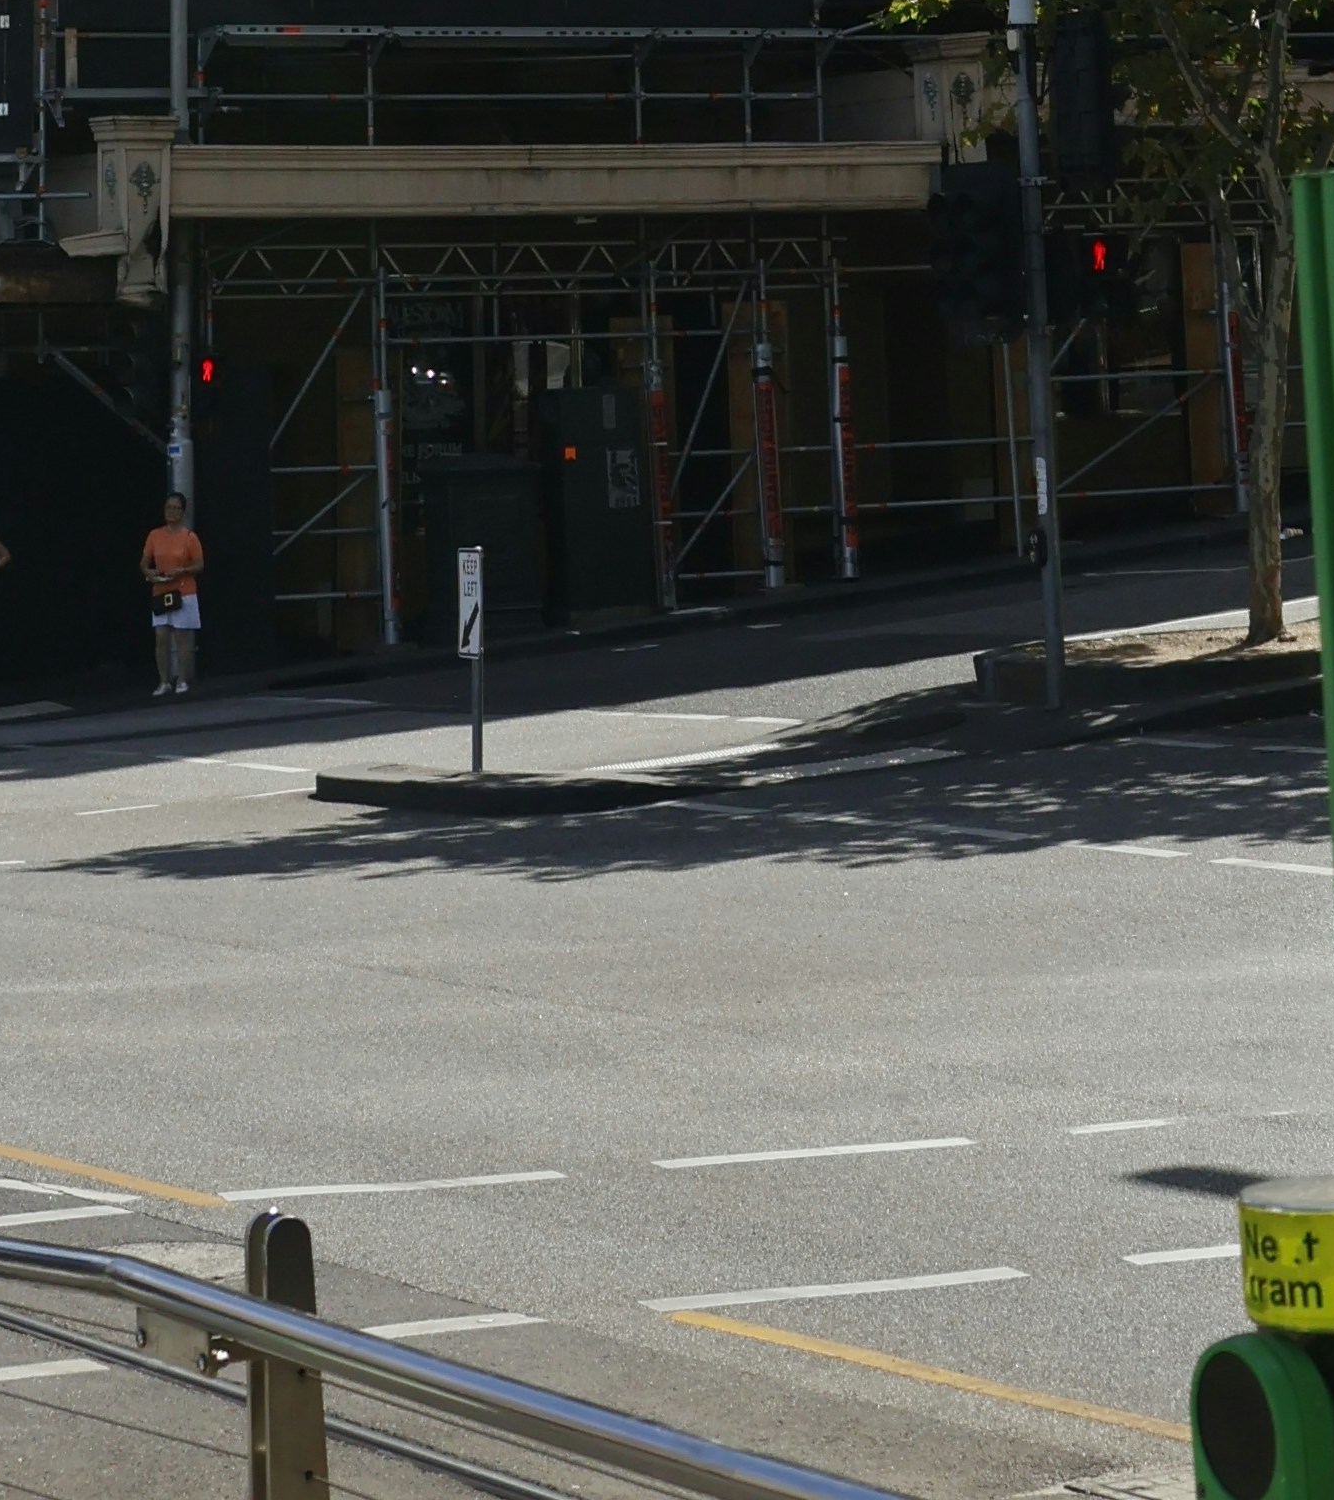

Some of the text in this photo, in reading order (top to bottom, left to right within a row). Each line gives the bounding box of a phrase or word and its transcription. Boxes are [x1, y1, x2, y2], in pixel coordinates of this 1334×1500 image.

[463, 560, 477, 575] KEEP
[464, 581, 477, 597] LEFT
[1245, 1220, 1320, 1263] Net
